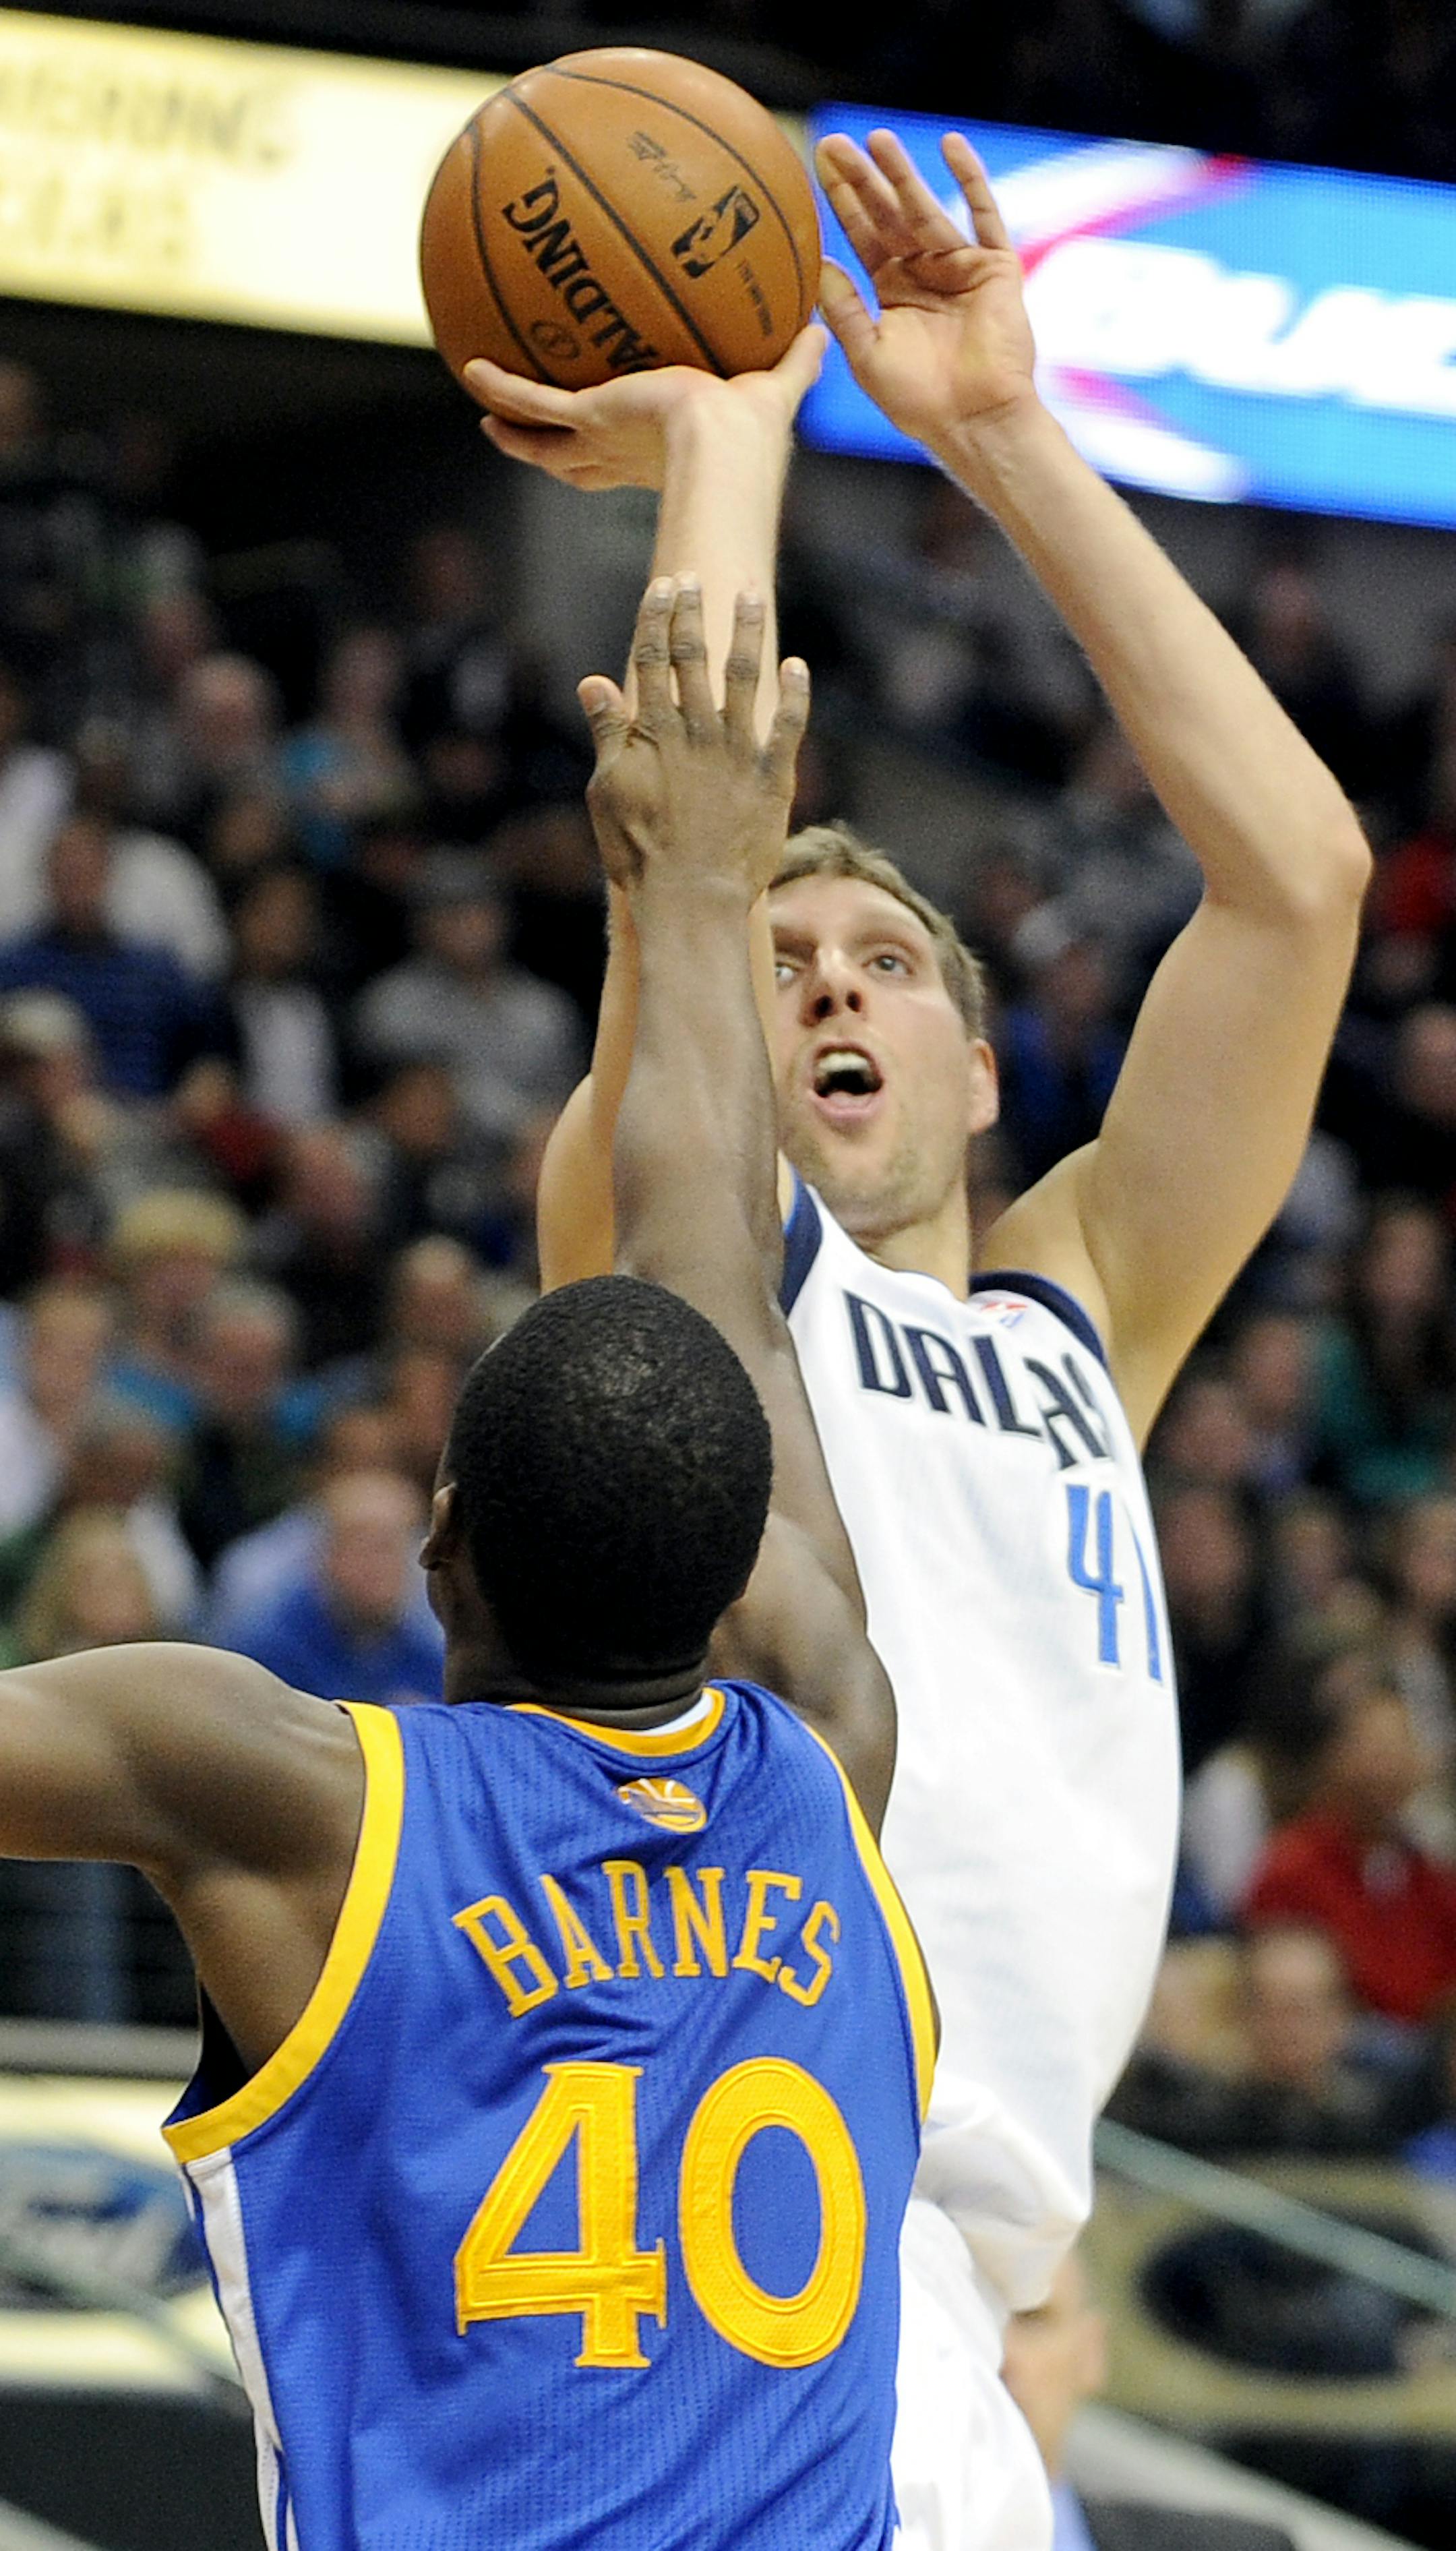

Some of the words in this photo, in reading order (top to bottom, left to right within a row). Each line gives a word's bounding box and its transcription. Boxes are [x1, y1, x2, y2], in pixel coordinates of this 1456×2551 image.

[502, 178, 660, 372] ALDING
[1066, 1484, 1162, 1681] 41
[452, 1859, 841, 2018] BARNES
[454, 2056, 867, 2370] 40
